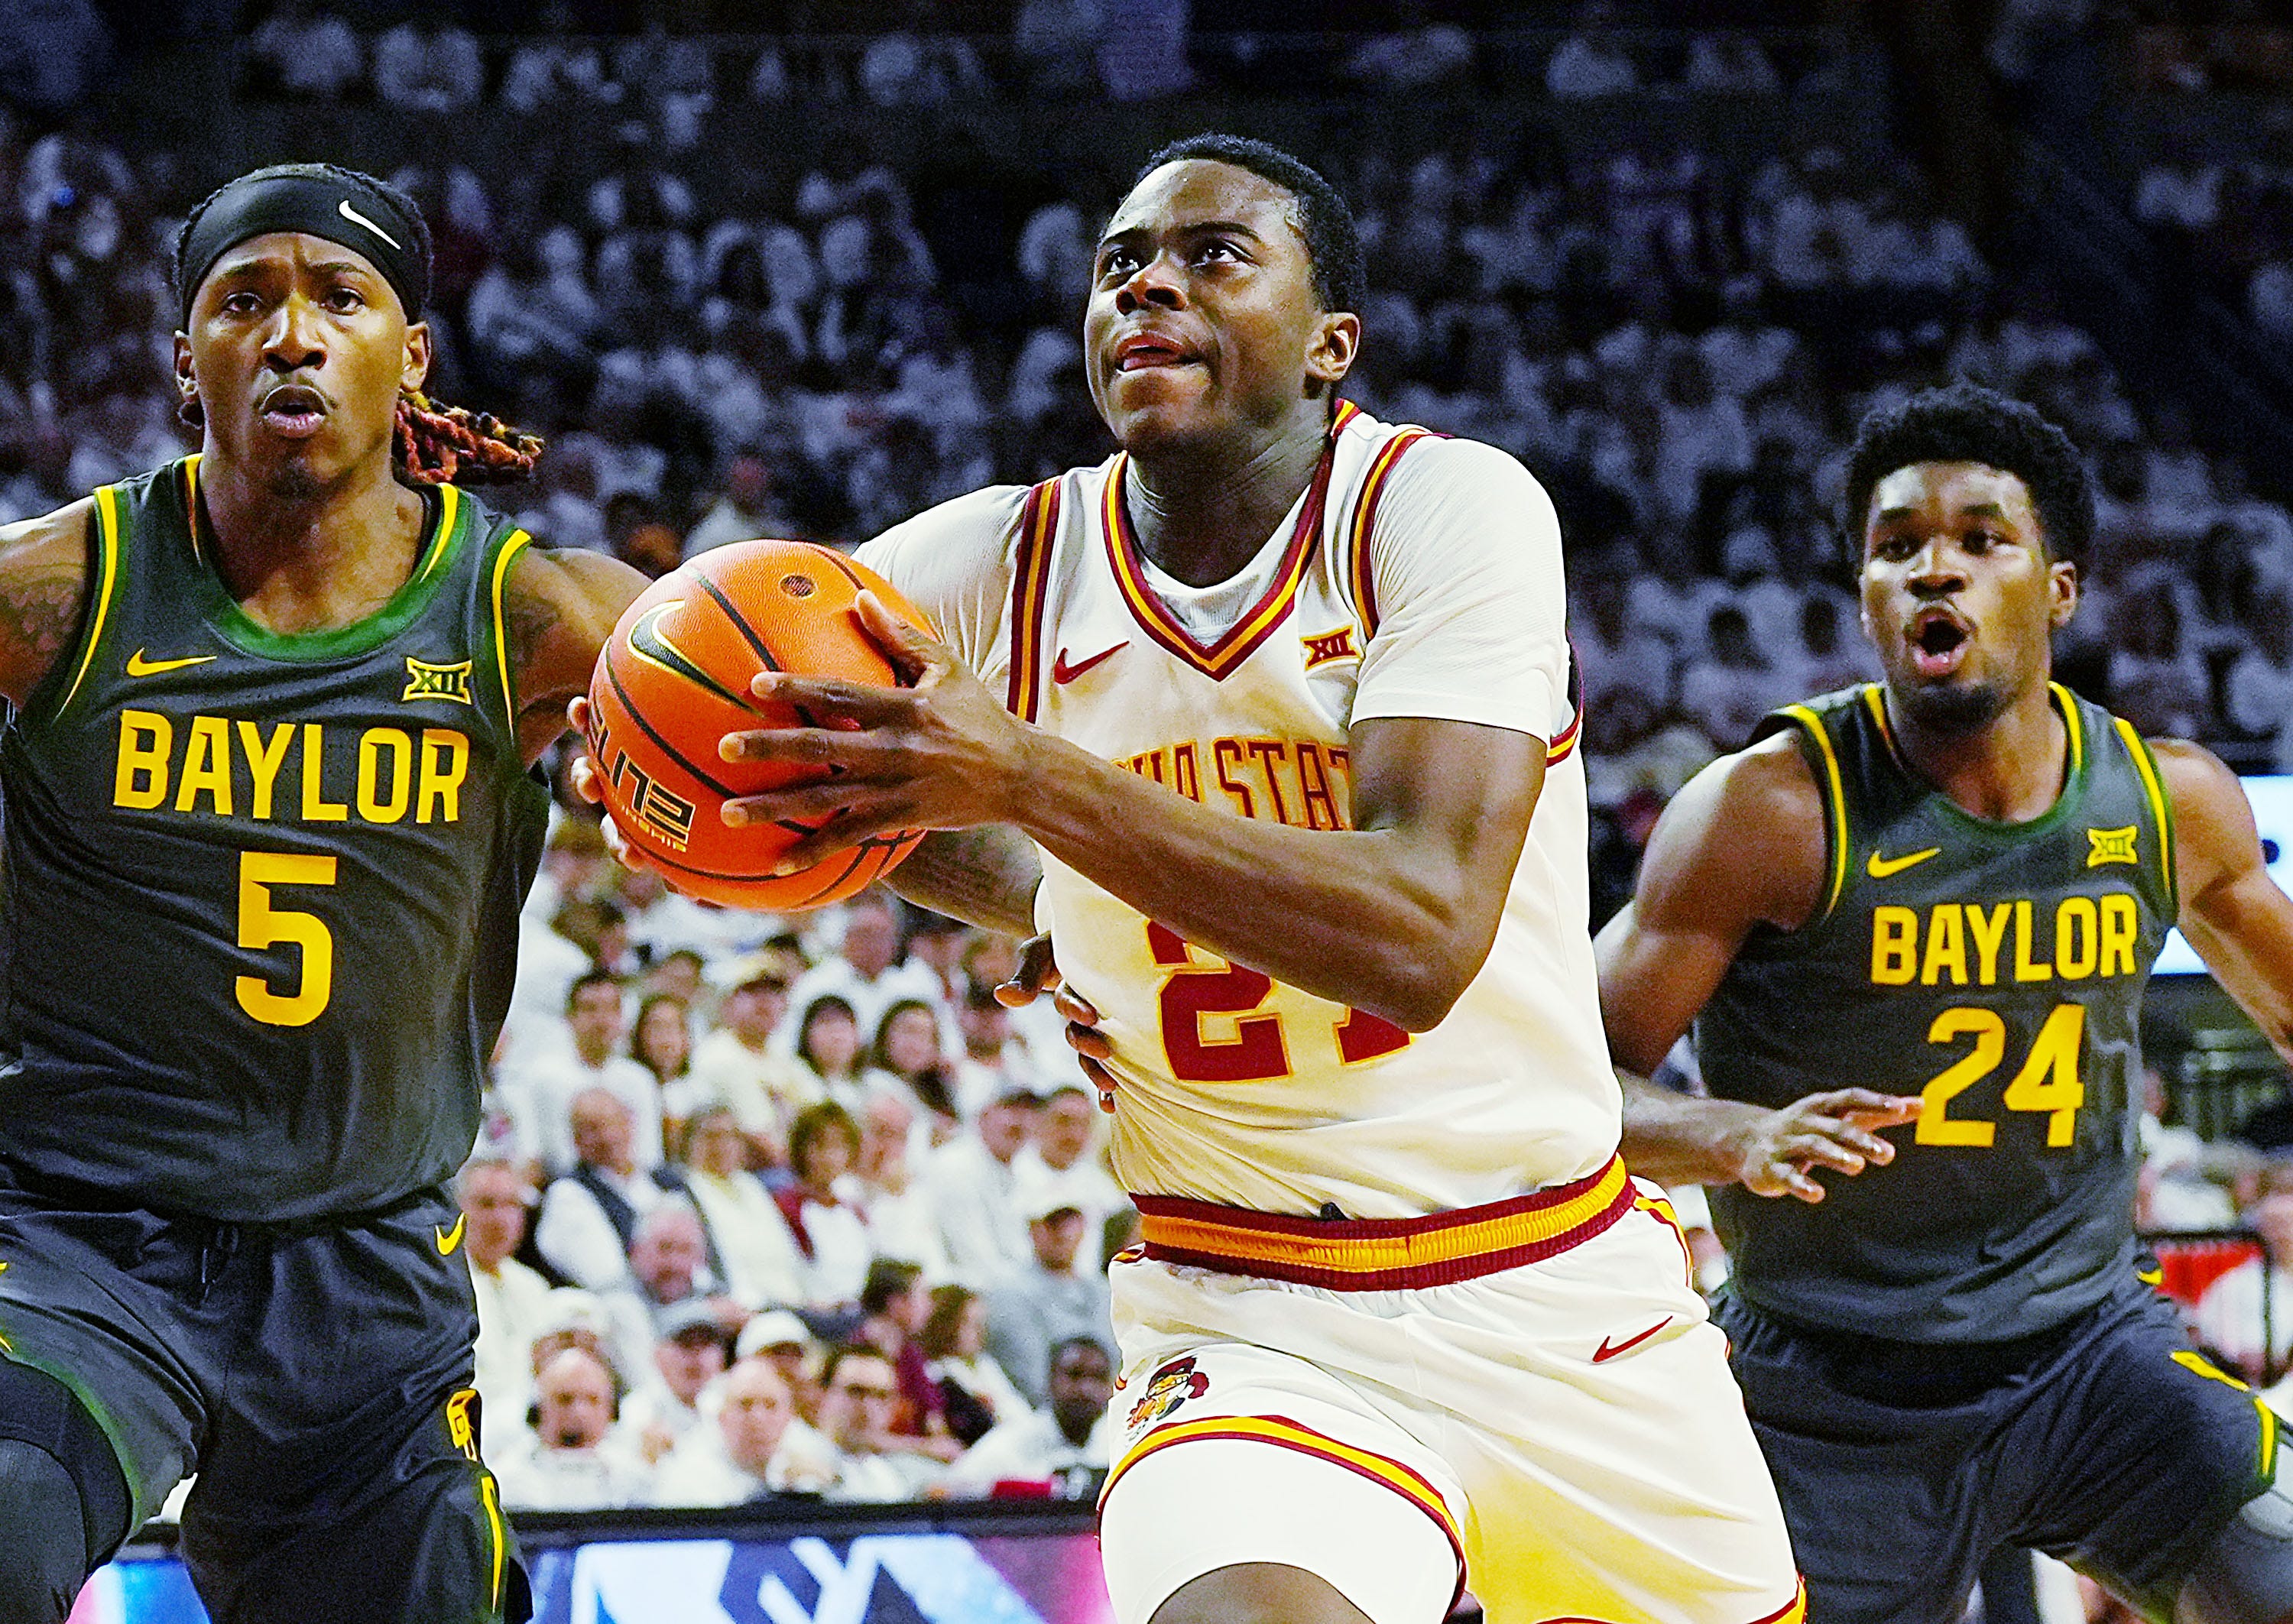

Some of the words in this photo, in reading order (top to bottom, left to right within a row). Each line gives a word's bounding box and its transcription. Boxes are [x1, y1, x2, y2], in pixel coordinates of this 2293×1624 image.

[406, 661, 469, 702] XII
[1301, 626, 1359, 669] XII
[113, 708, 469, 824] BAYLOR
[235, 851, 336, 1027] 5
[1870, 894, 2137, 986] BAYLOR
[1915, 1003, 2085, 1146] 24
